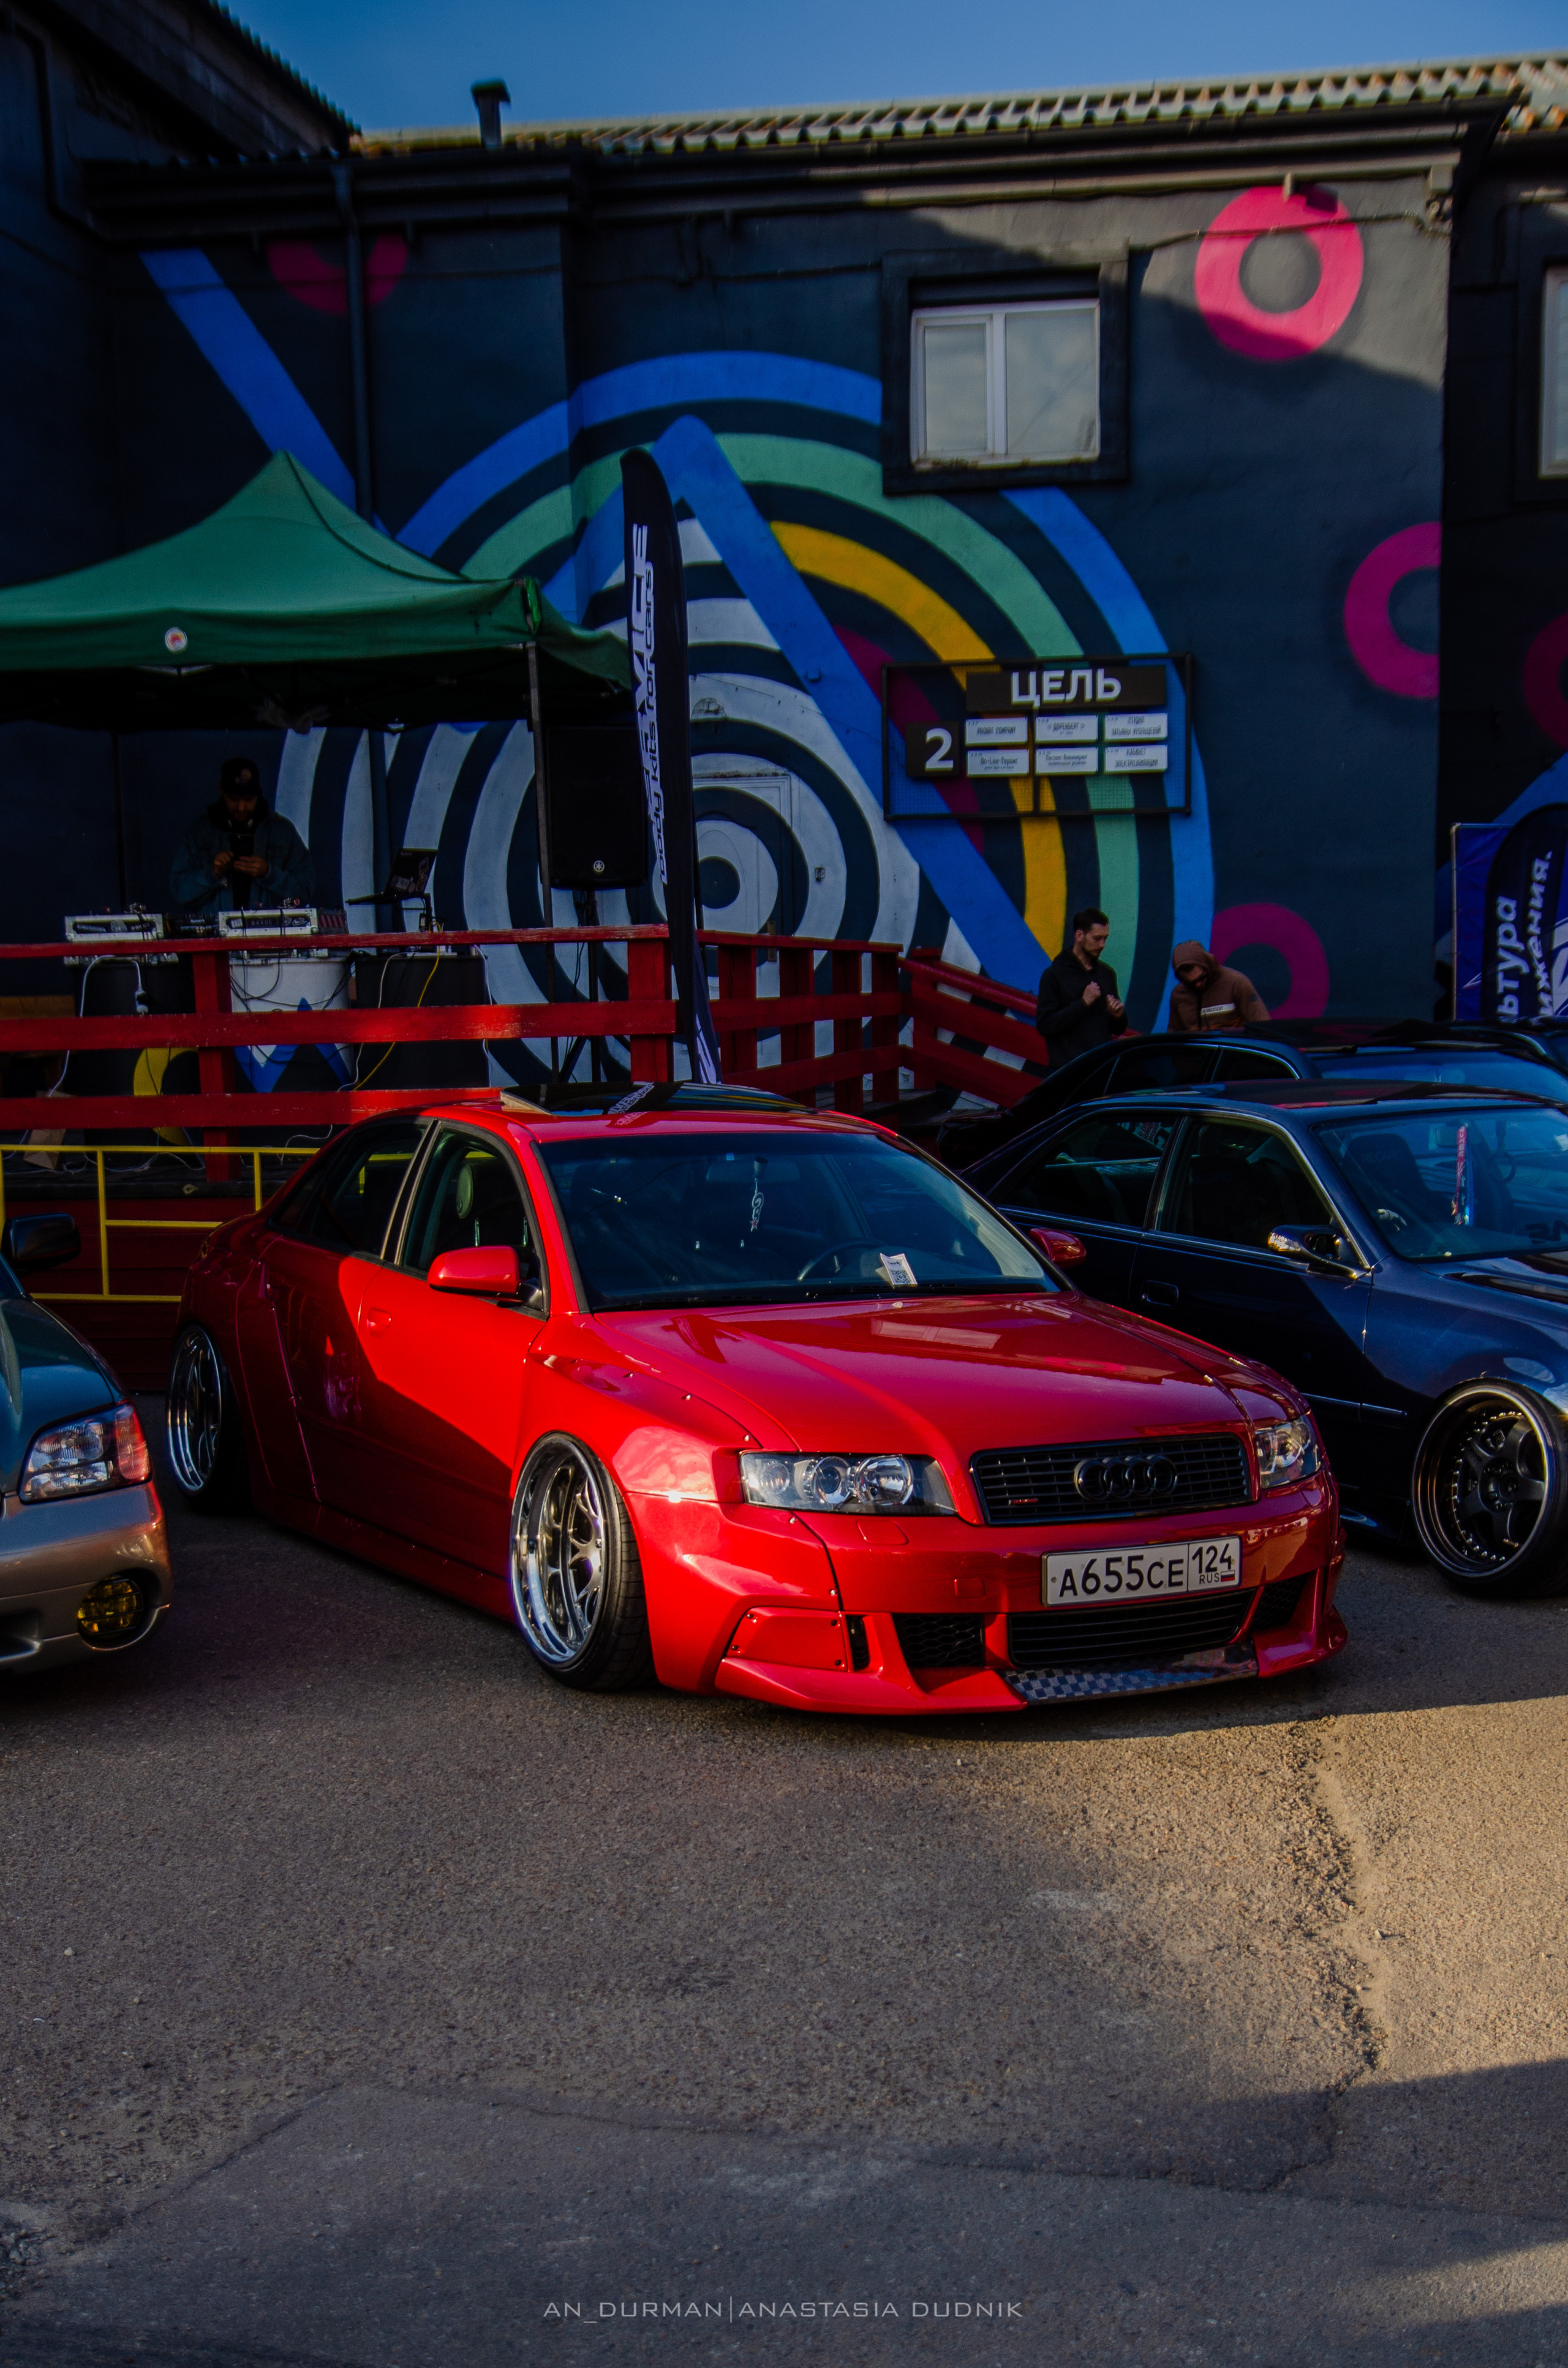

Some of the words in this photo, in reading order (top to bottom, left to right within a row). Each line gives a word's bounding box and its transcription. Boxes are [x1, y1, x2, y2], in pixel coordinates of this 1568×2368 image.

[646, 658, 655, 711] for
[1011, 668, 1122, 709] ЦЕЛЬ
[649, 720, 658, 782] kits
[924, 727, 954, 772] 2
[653, 791, 665, 878] body
[1191, 1543, 1233, 1574] 124
[1199, 1572, 1220, 1585] RUS
